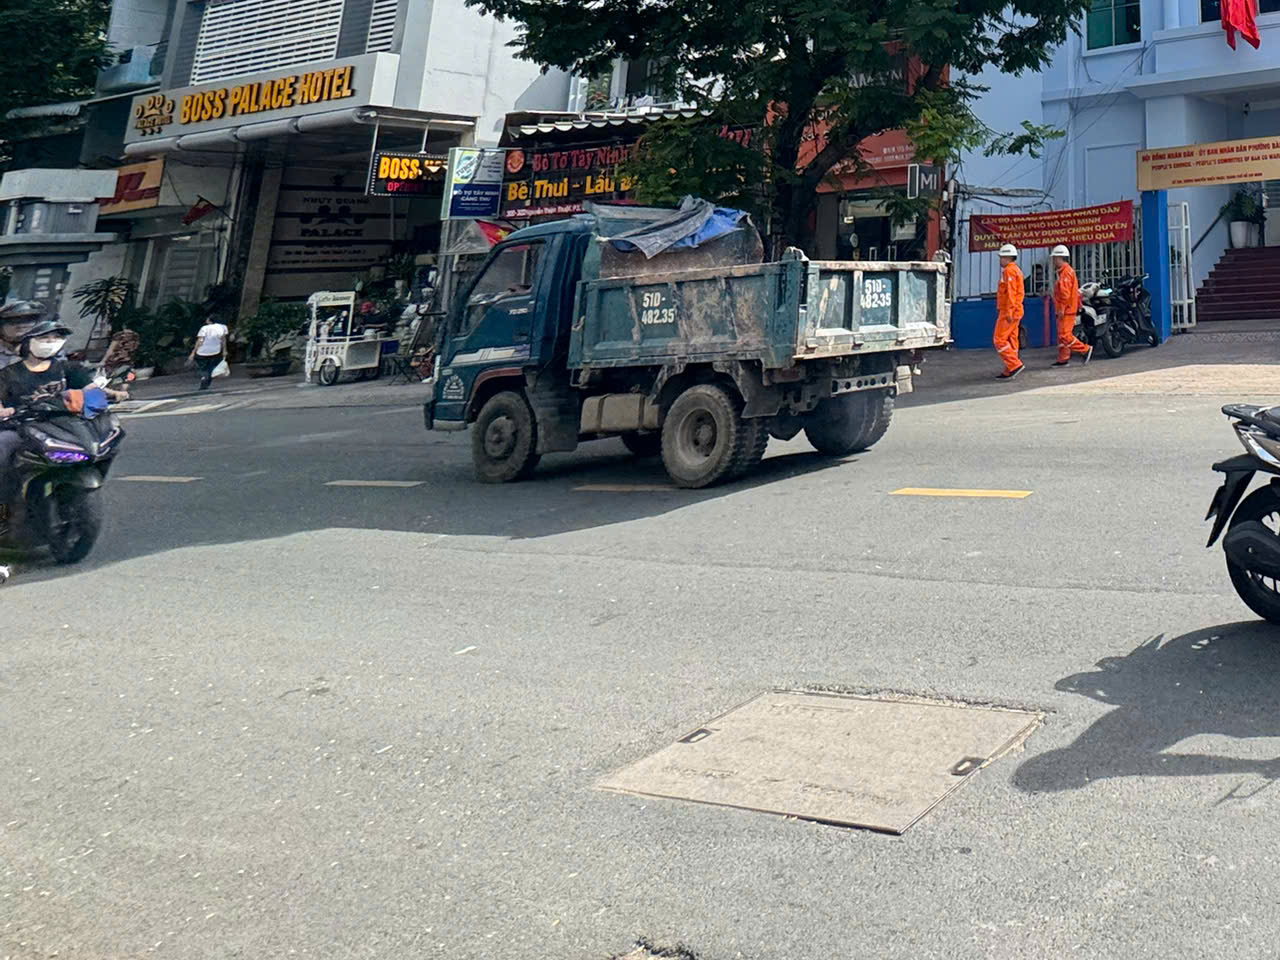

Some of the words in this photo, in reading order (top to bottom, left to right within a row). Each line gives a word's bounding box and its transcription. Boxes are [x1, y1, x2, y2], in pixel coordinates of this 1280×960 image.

[180, 88, 226, 124] BOSS
[229, 75, 297, 115] PALACE
[298, 65, 354, 104] HOTEL
[379, 157, 420, 180] BOSS
[534, 176, 568, 199] Thui
[641, 308, 675, 325] 482.35
